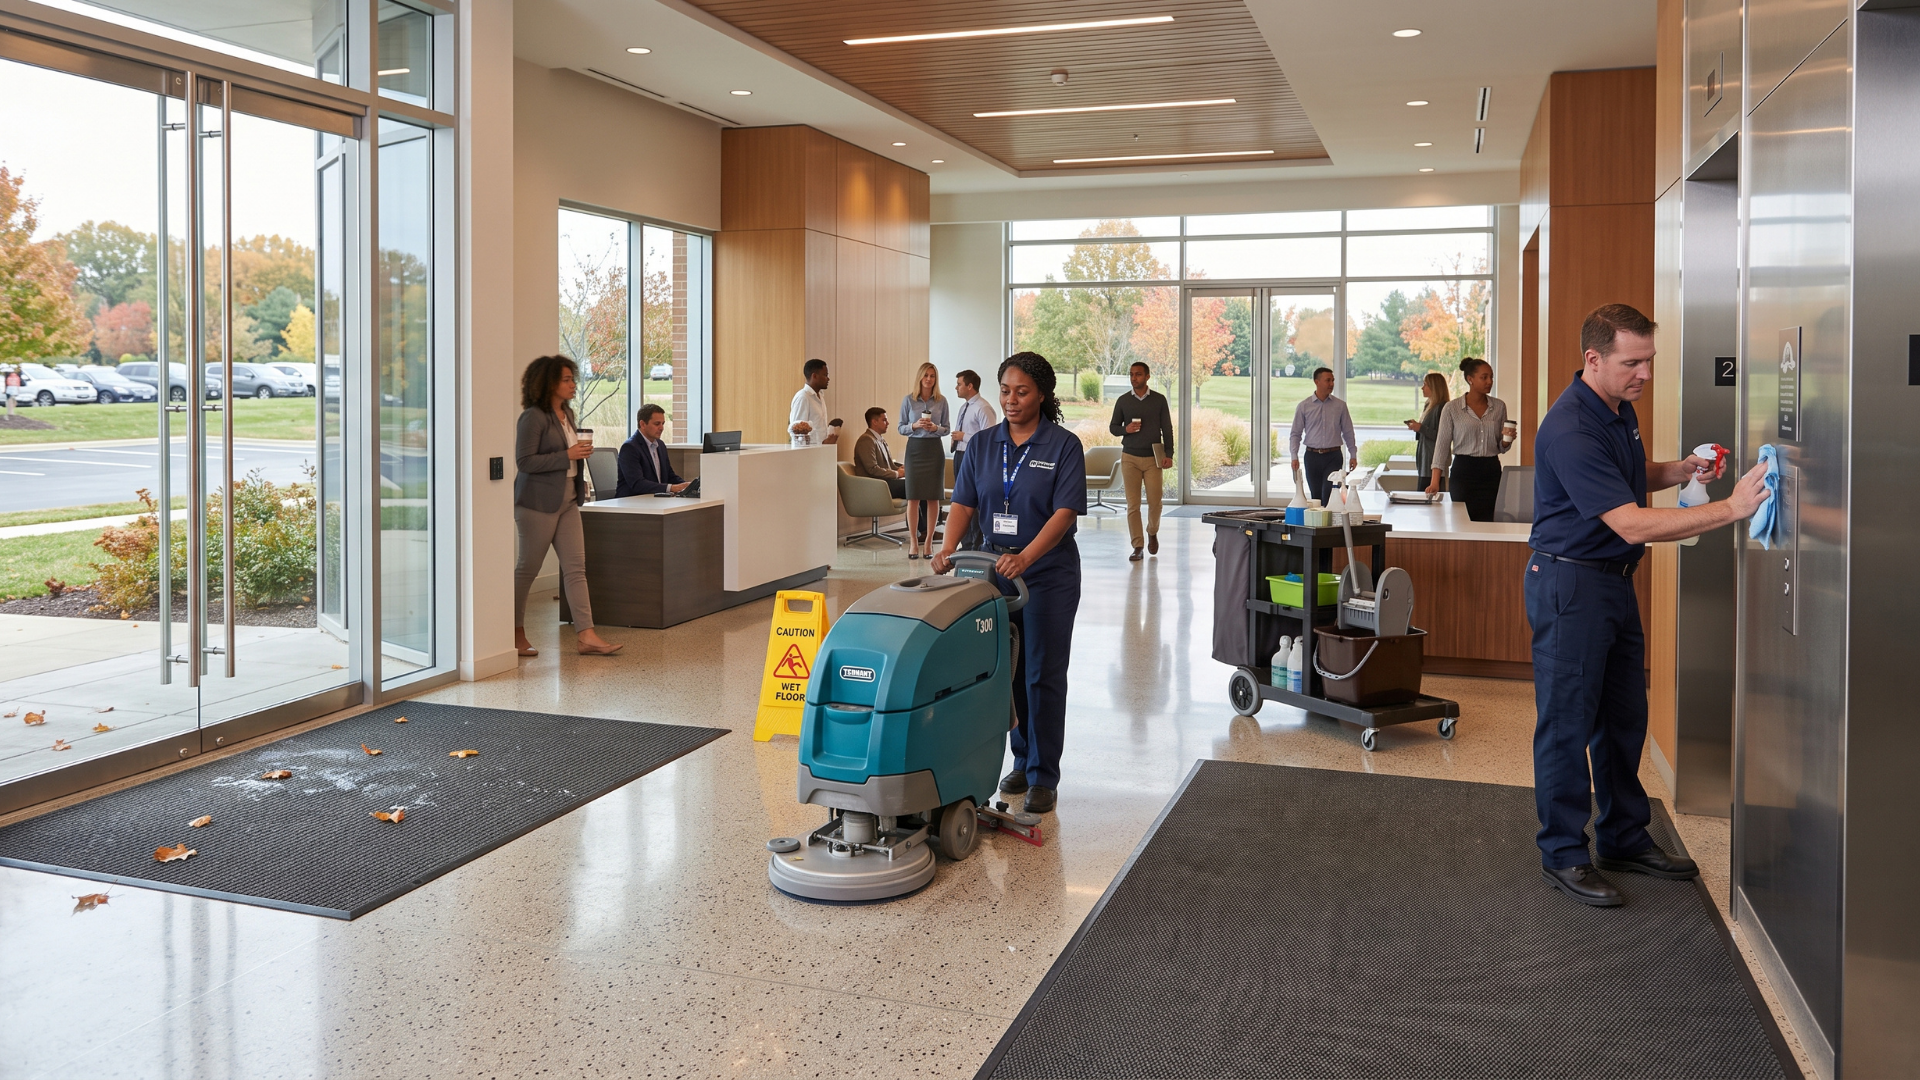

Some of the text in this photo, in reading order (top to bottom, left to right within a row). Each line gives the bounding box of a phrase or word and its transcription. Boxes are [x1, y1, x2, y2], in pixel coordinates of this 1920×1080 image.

[1722, 361, 1734, 377] 2
[975, 617, 993, 634] T300
[776, 627, 815, 637] CAUTION
[781, 682, 801, 692] WET
[775, 692, 806, 702] FLOOR
